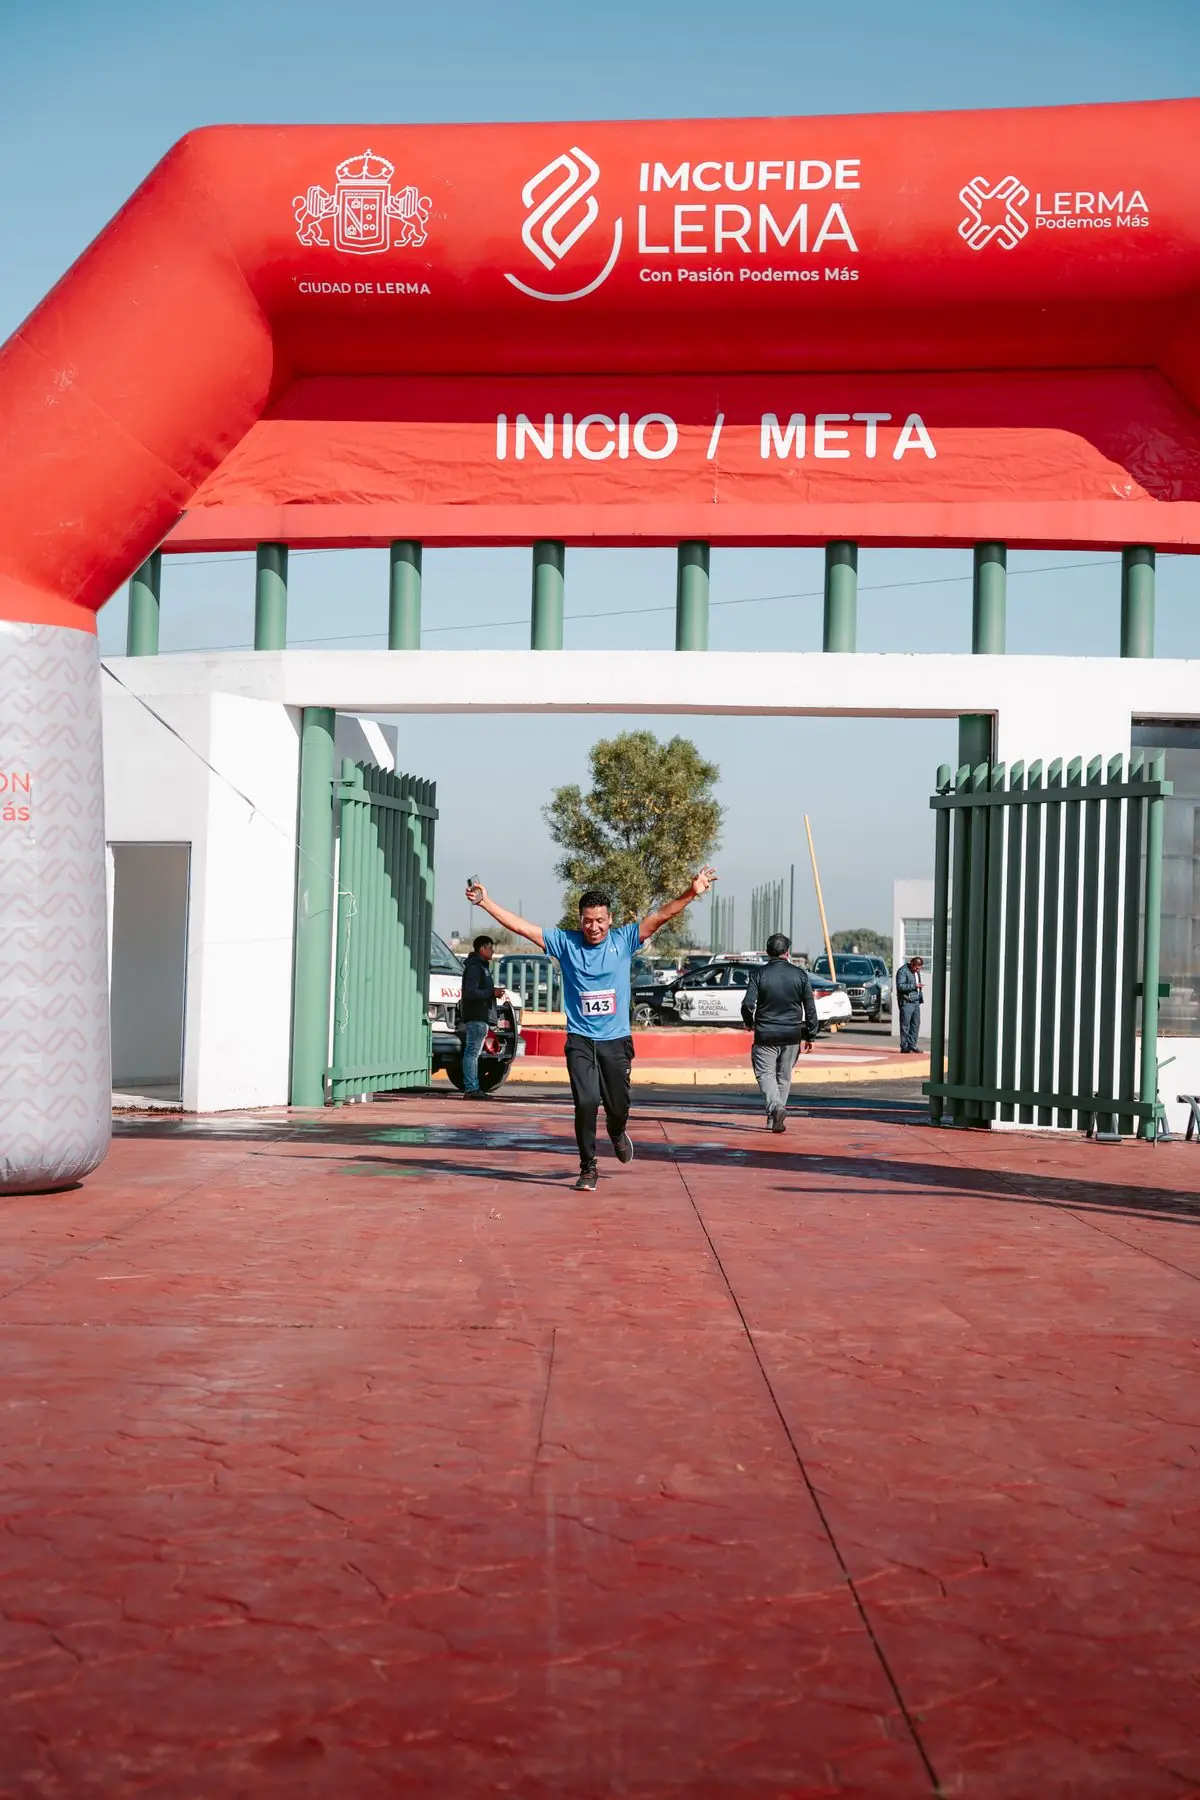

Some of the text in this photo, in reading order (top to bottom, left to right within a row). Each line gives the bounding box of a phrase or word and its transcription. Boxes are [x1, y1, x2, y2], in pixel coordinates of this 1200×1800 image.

[639, 159, 861, 192] IMCUFIDE
[1035, 190, 1149, 215] LERMA
[638, 202, 859, 254] LERMA
[1035, 214, 1149, 229] Podemos Más
[639, 266, 860, 282] Con Pasión Podemos Más
[298, 282, 431, 295] CIUDAD DE LERMA
[496, 413, 679, 461] INICIO
[760, 413, 937, 461] META
[585, 1000, 610, 1013] 143
